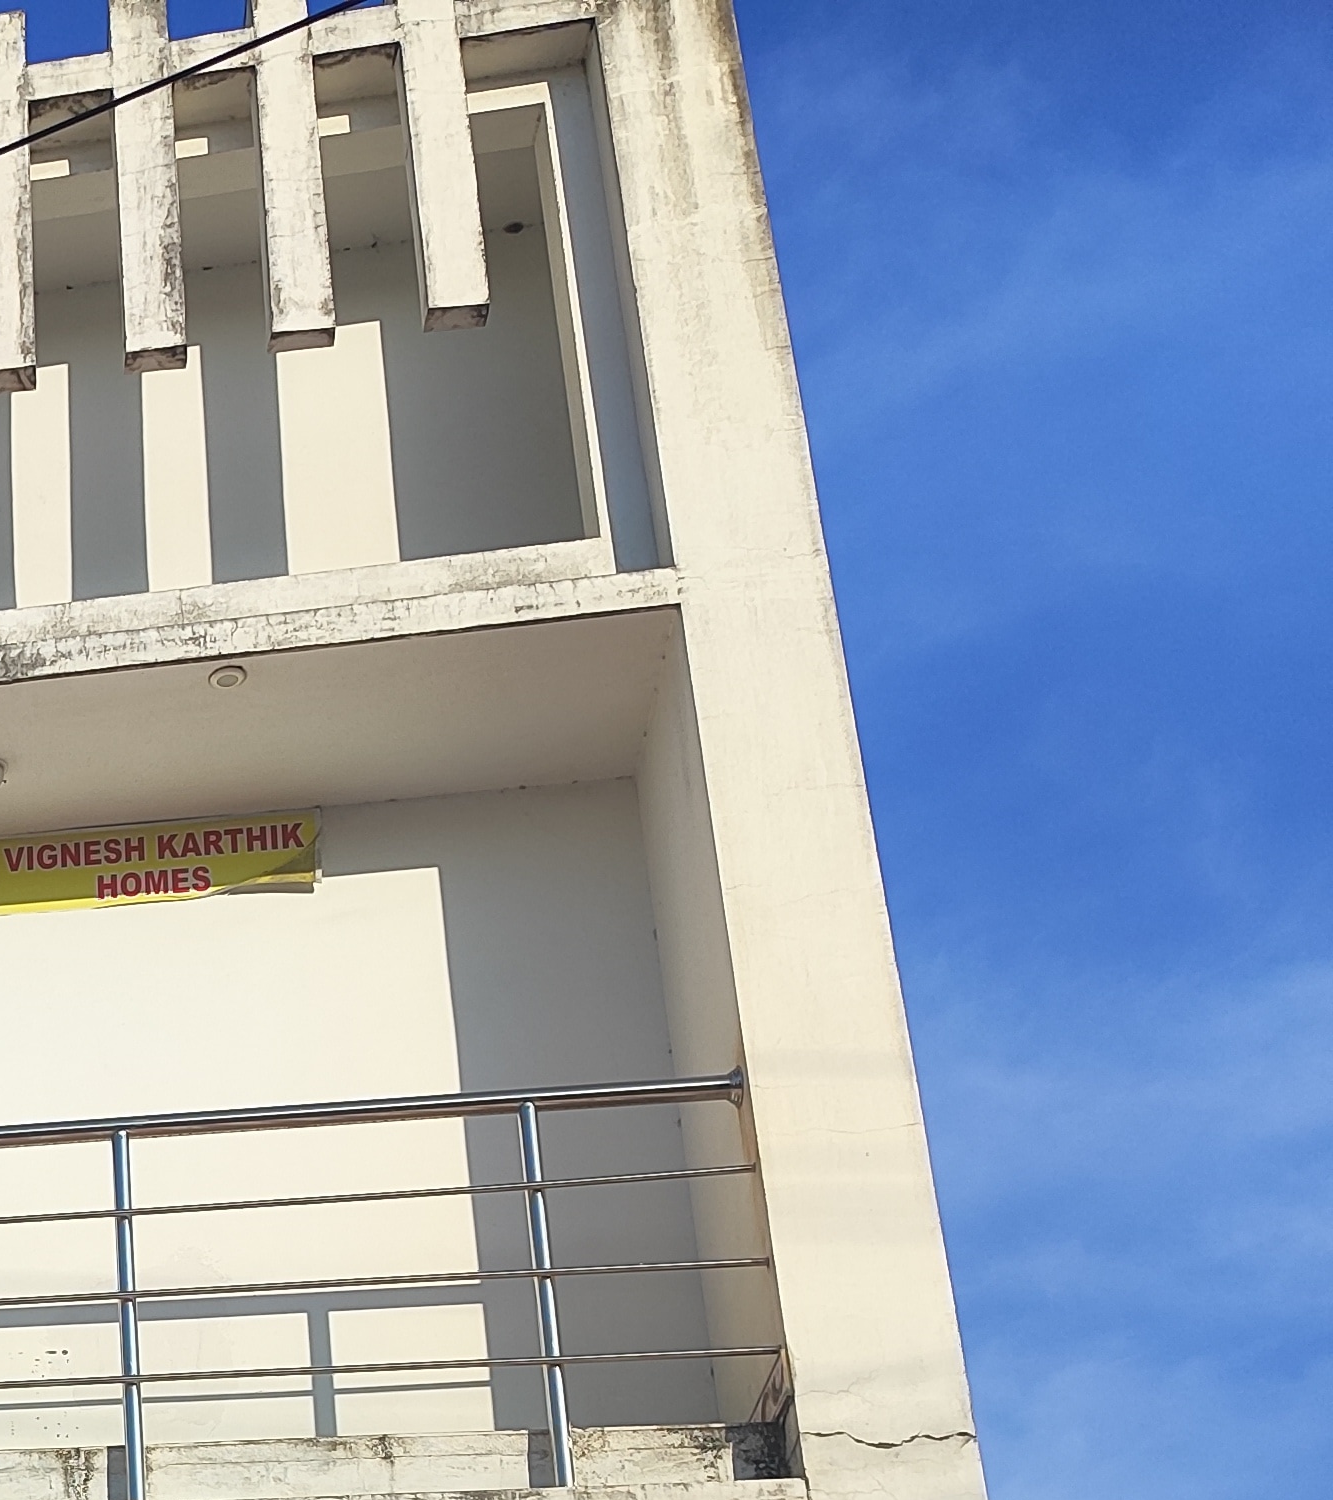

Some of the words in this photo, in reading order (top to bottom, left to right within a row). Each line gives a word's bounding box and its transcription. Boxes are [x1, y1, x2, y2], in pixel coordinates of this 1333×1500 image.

[4, 836, 145, 872] VIGNESH
[157, 822, 304, 860] KARTHIK
[96, 866, 212, 900] HOMES
